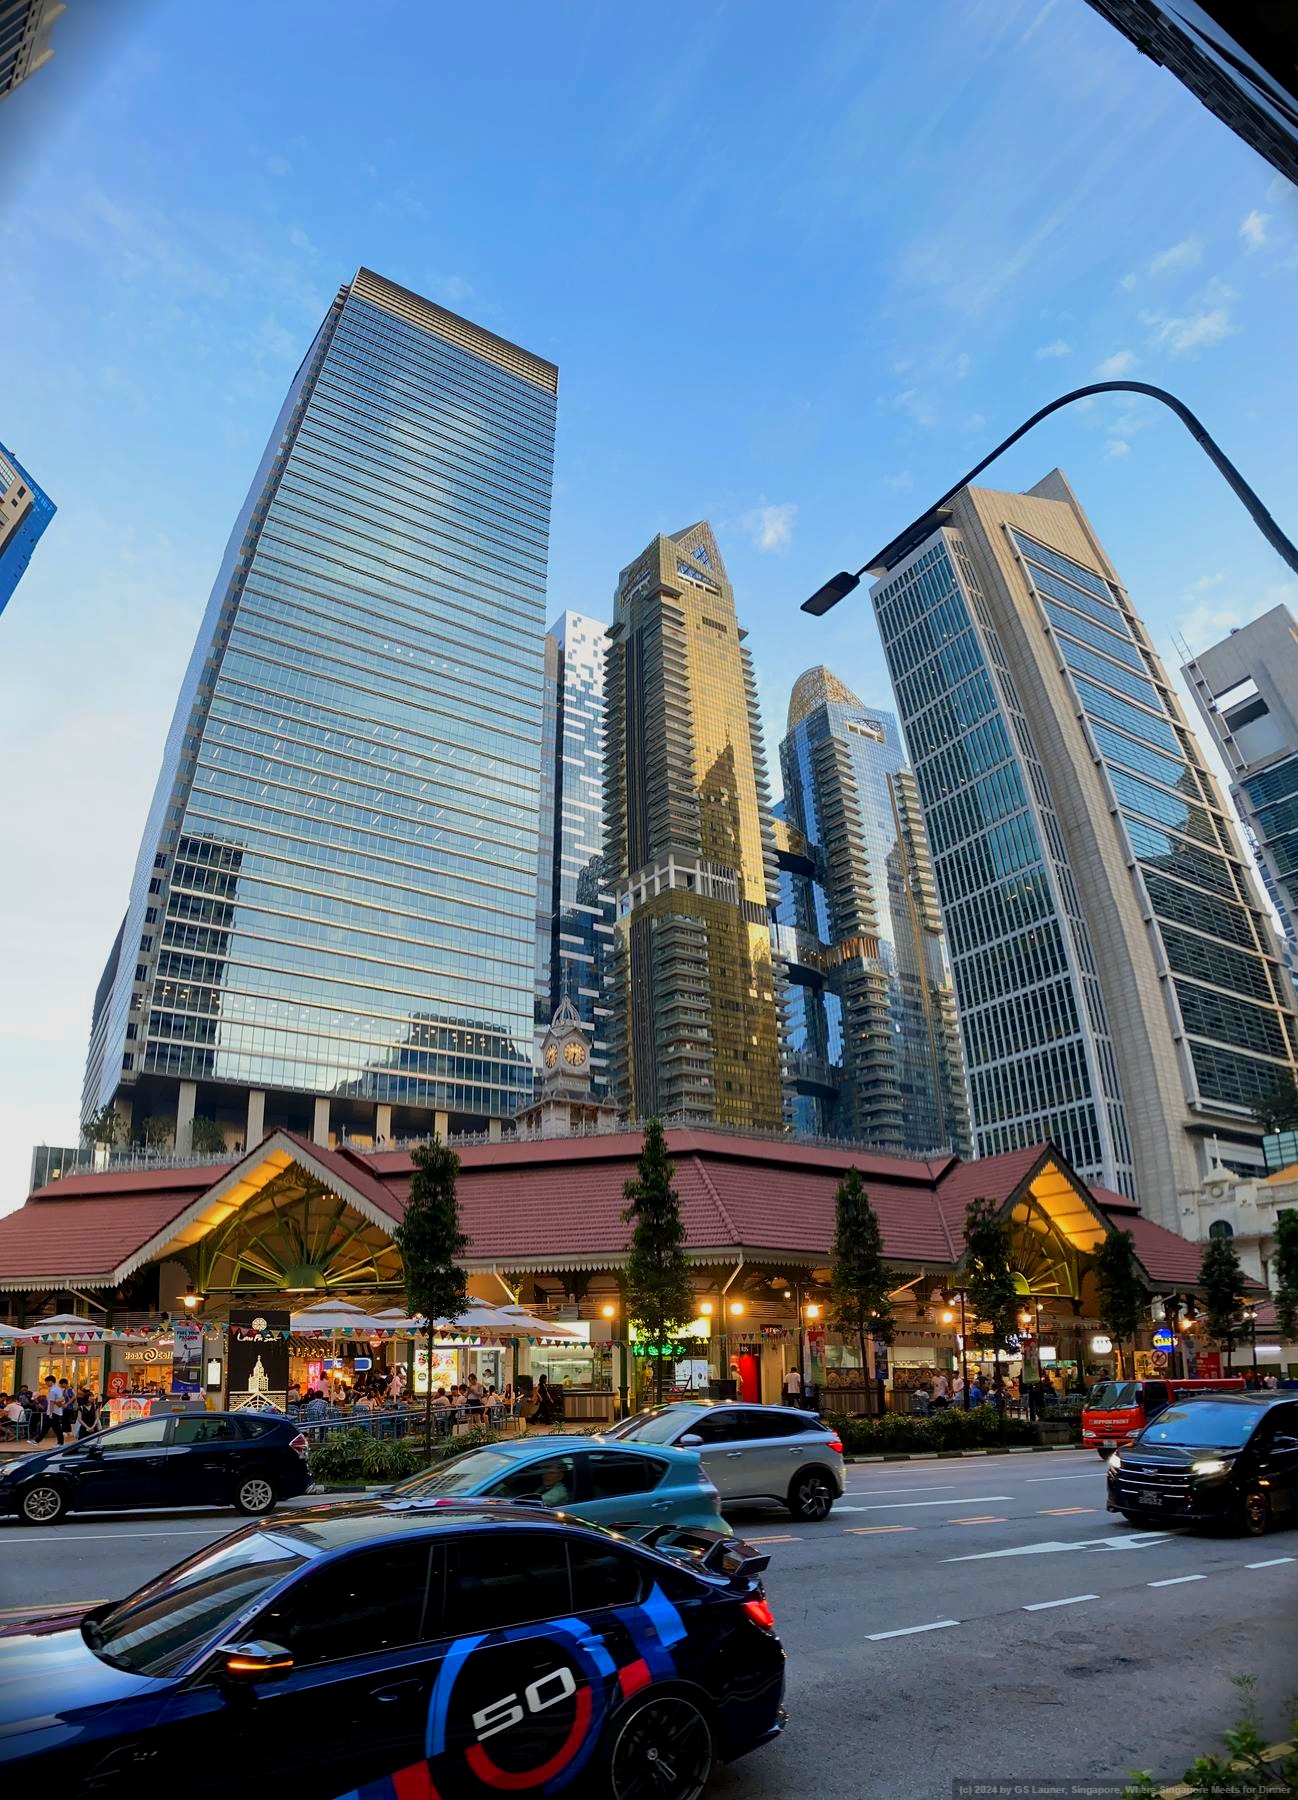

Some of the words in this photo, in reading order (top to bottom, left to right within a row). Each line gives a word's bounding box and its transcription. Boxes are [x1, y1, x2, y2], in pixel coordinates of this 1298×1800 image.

[237, 1332, 254, 1342] Lau
[254, 1333, 263, 1342] Pa
[263, 1334, 282, 1343] Sat
[124, 1351, 143, 1360] Hook
[472, 1667, 577, 1741] 50
